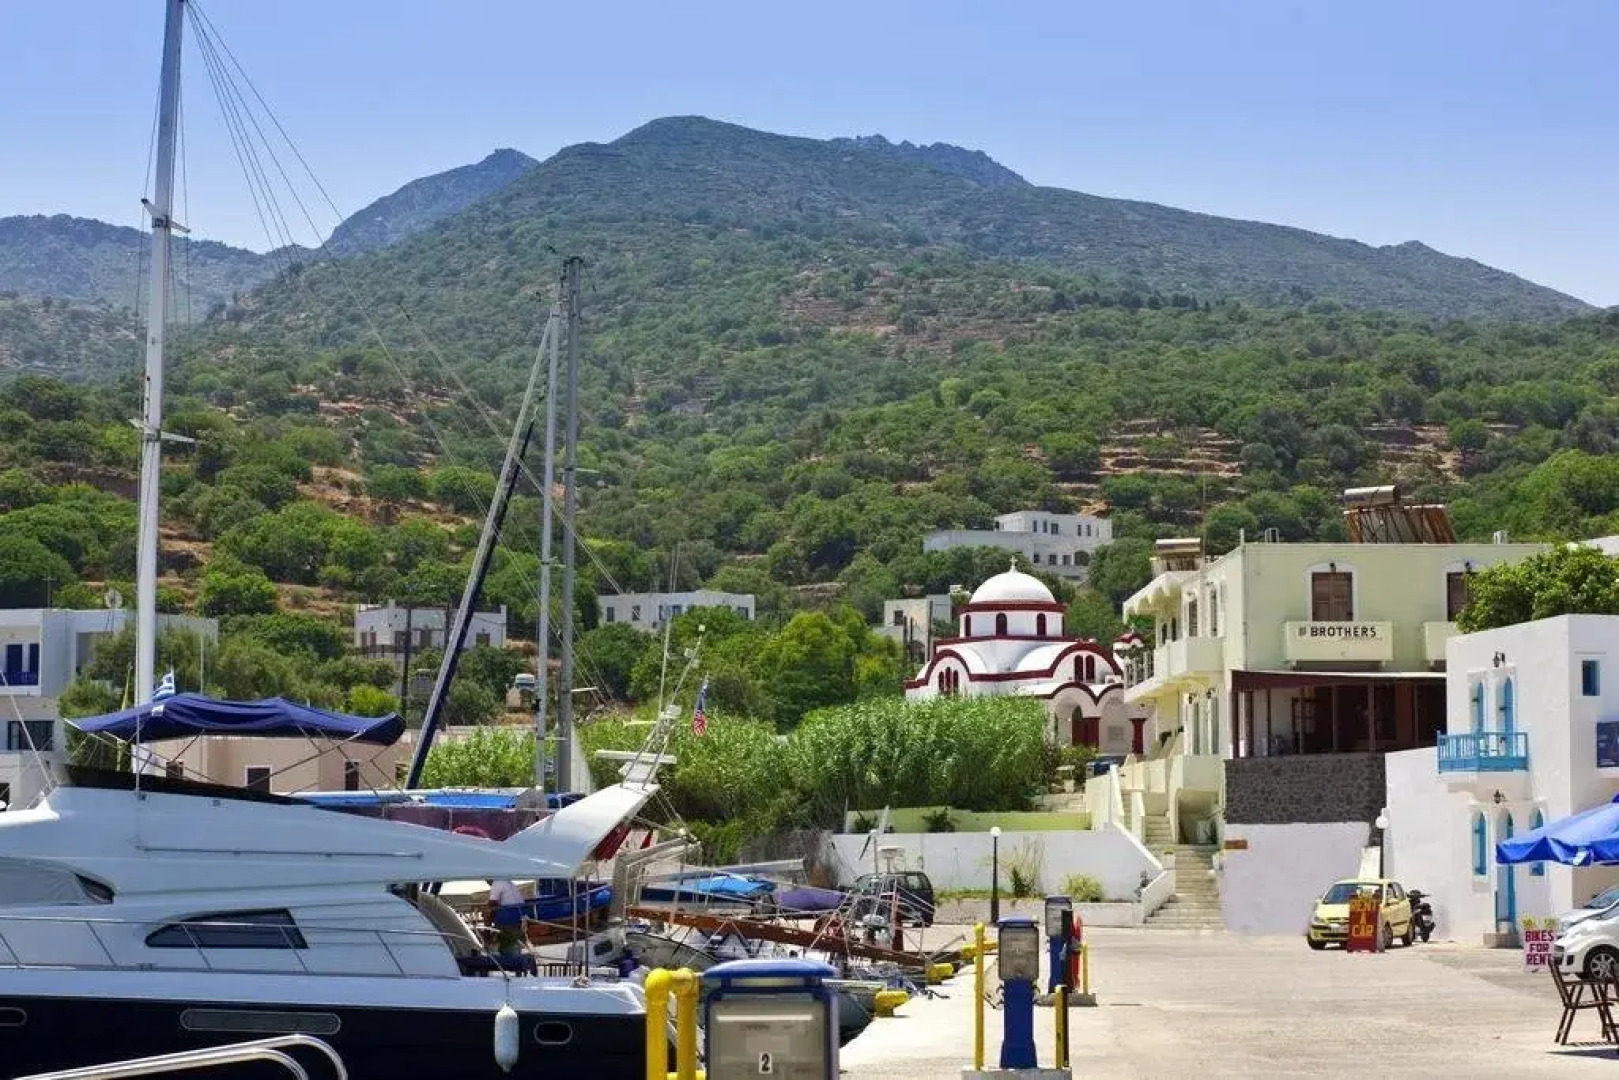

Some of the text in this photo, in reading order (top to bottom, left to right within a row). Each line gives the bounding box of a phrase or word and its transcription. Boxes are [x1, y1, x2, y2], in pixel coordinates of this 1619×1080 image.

[1310, 626, 1377, 637] BROTHERS
[1525, 930, 1554, 942] BIKES
[1529, 943, 1550, 953] FOR
[1526, 953, 1552, 965] RENT
[761, 1052, 770, 1072] 2
